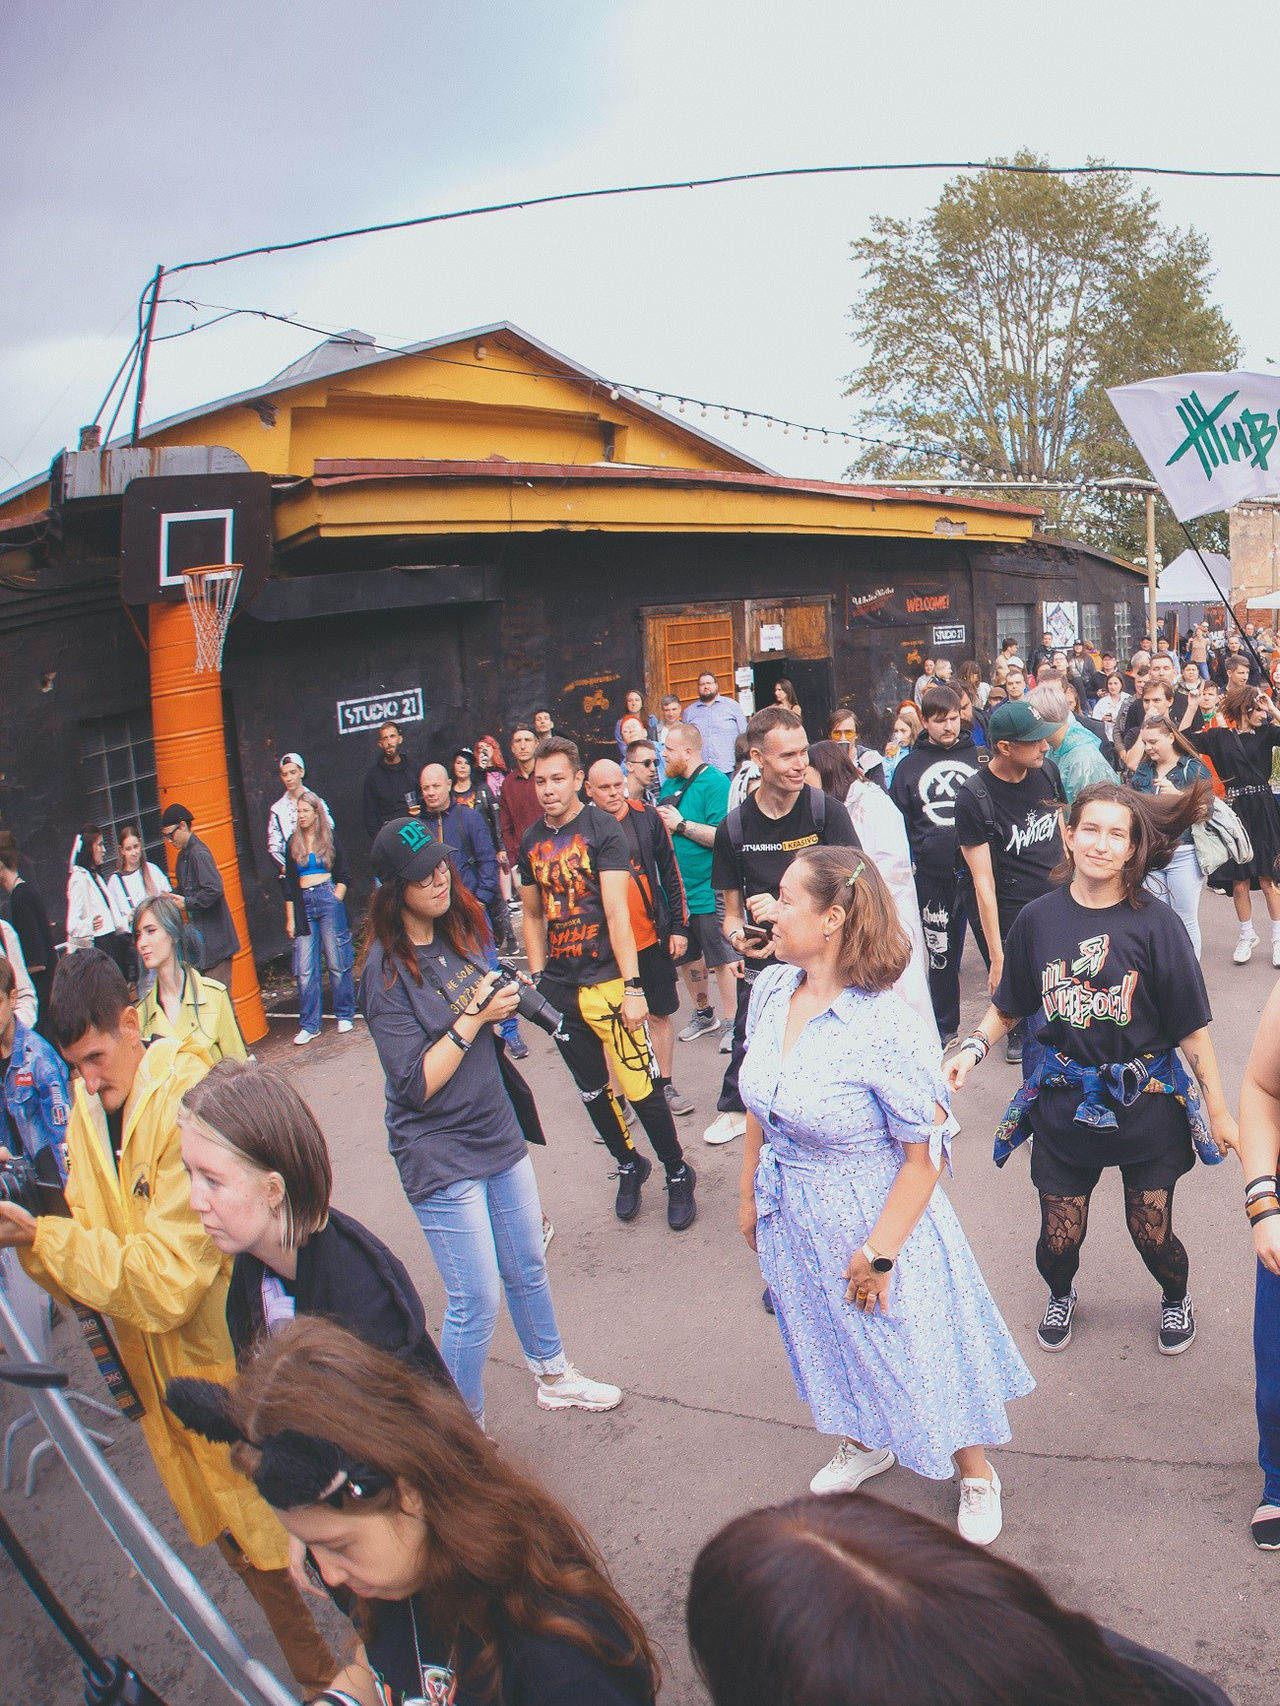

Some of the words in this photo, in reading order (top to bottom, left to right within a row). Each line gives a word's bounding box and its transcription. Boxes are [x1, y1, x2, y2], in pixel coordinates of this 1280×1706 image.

[906, 594, 950, 612] WELCOME!
[935, 629, 957, 641] STUDIO
[957, 628, 964, 640] 21
[344, 700, 399, 725] STUDIO
[401, 696, 417, 716] 21
[1071, 933, 1111, 978] Я
